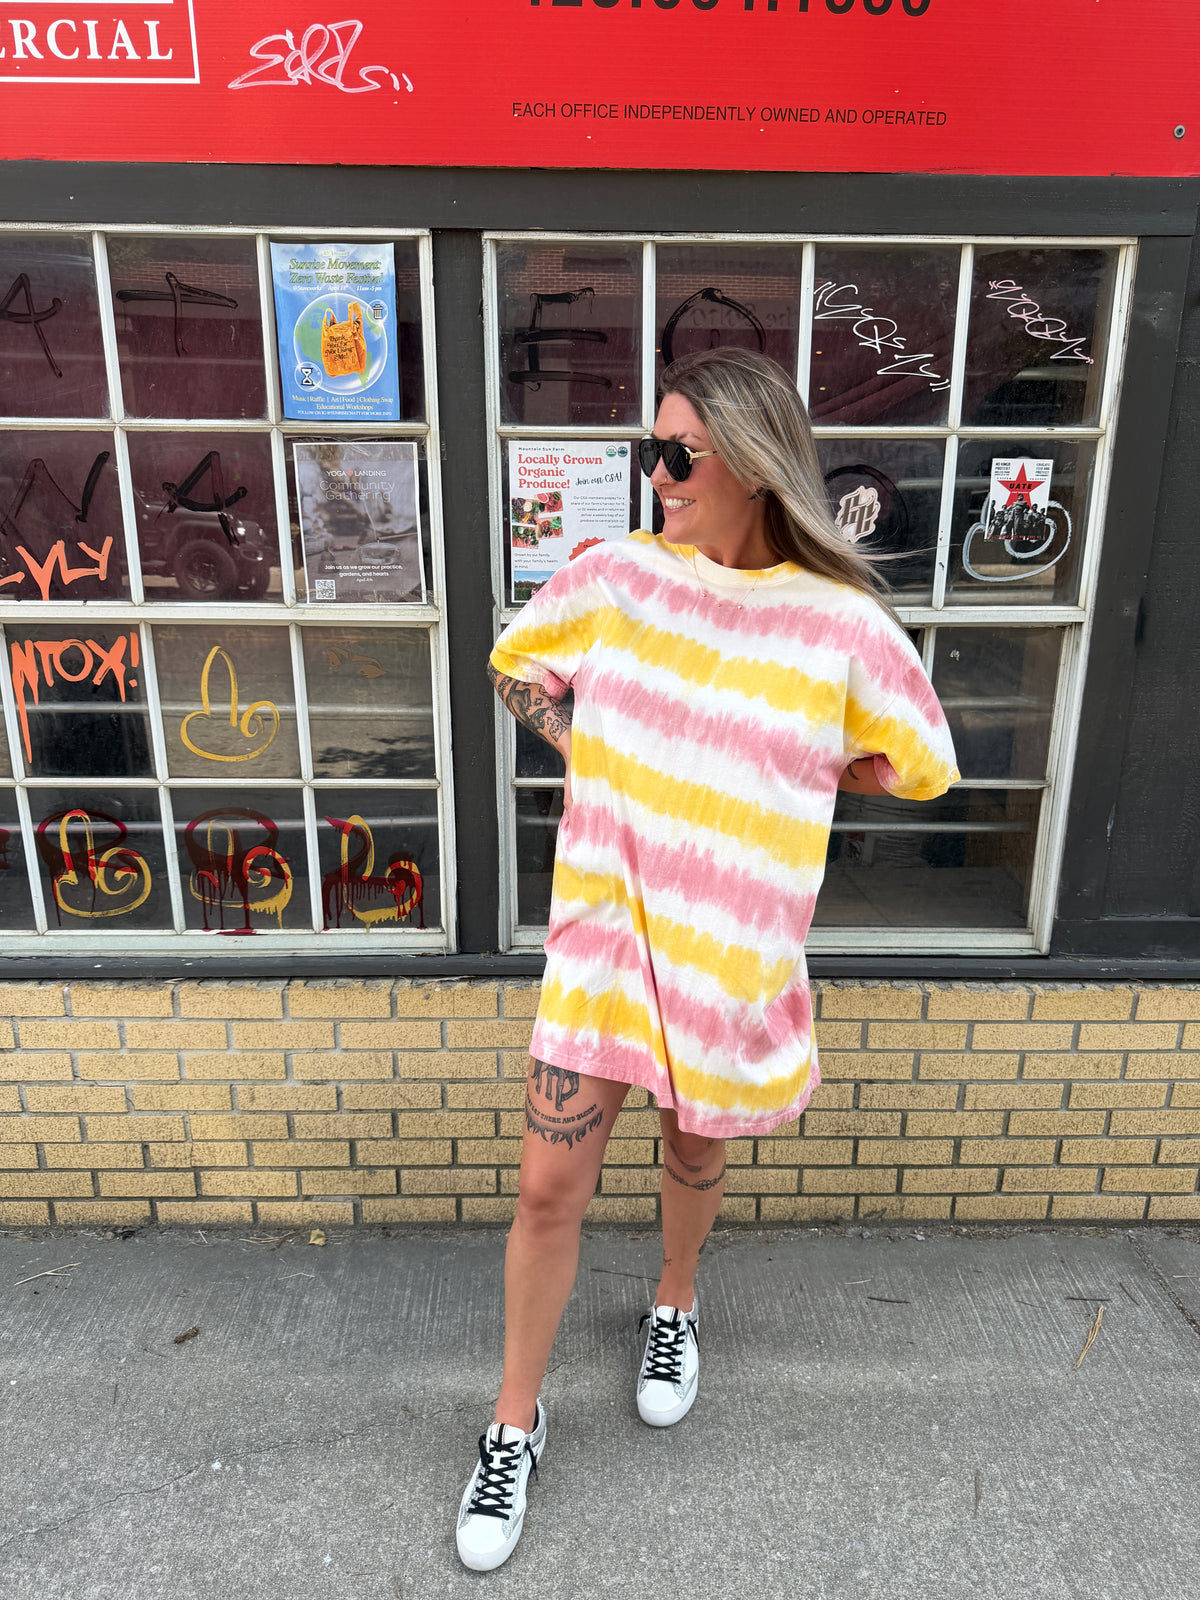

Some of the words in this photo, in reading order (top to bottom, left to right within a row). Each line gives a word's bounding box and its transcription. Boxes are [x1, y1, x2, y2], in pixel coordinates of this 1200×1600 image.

[0, 19, 173, 60] RCIAL
[512, 102, 556, 118] EACH
[560, 103, 619, 119] OFFICE
[624, 104, 756, 121] INDEPENDENTLY
[760, 107, 820, 123] OWNED
[824, 109, 858, 124] AND
[862, 110, 947, 126] OPERATED
[289, 258, 326, 270] Sunrise
[289, 272, 313, 284] Zero
[314, 272, 344, 284] Waste
[346, 272, 384, 284] Festival
[518, 453, 560, 466] Locally
[562, 454, 603, 465] Grown
[518, 466, 565, 478] Organic
[575, 477, 590, 486] Join
[604, 471, 623, 482] CSA!
[319, 480, 396, 493] Community
[518, 478, 570, 489] Produce!
[325, 490, 391, 503] Gathering
[562, 1115, 576, 1125] AND
